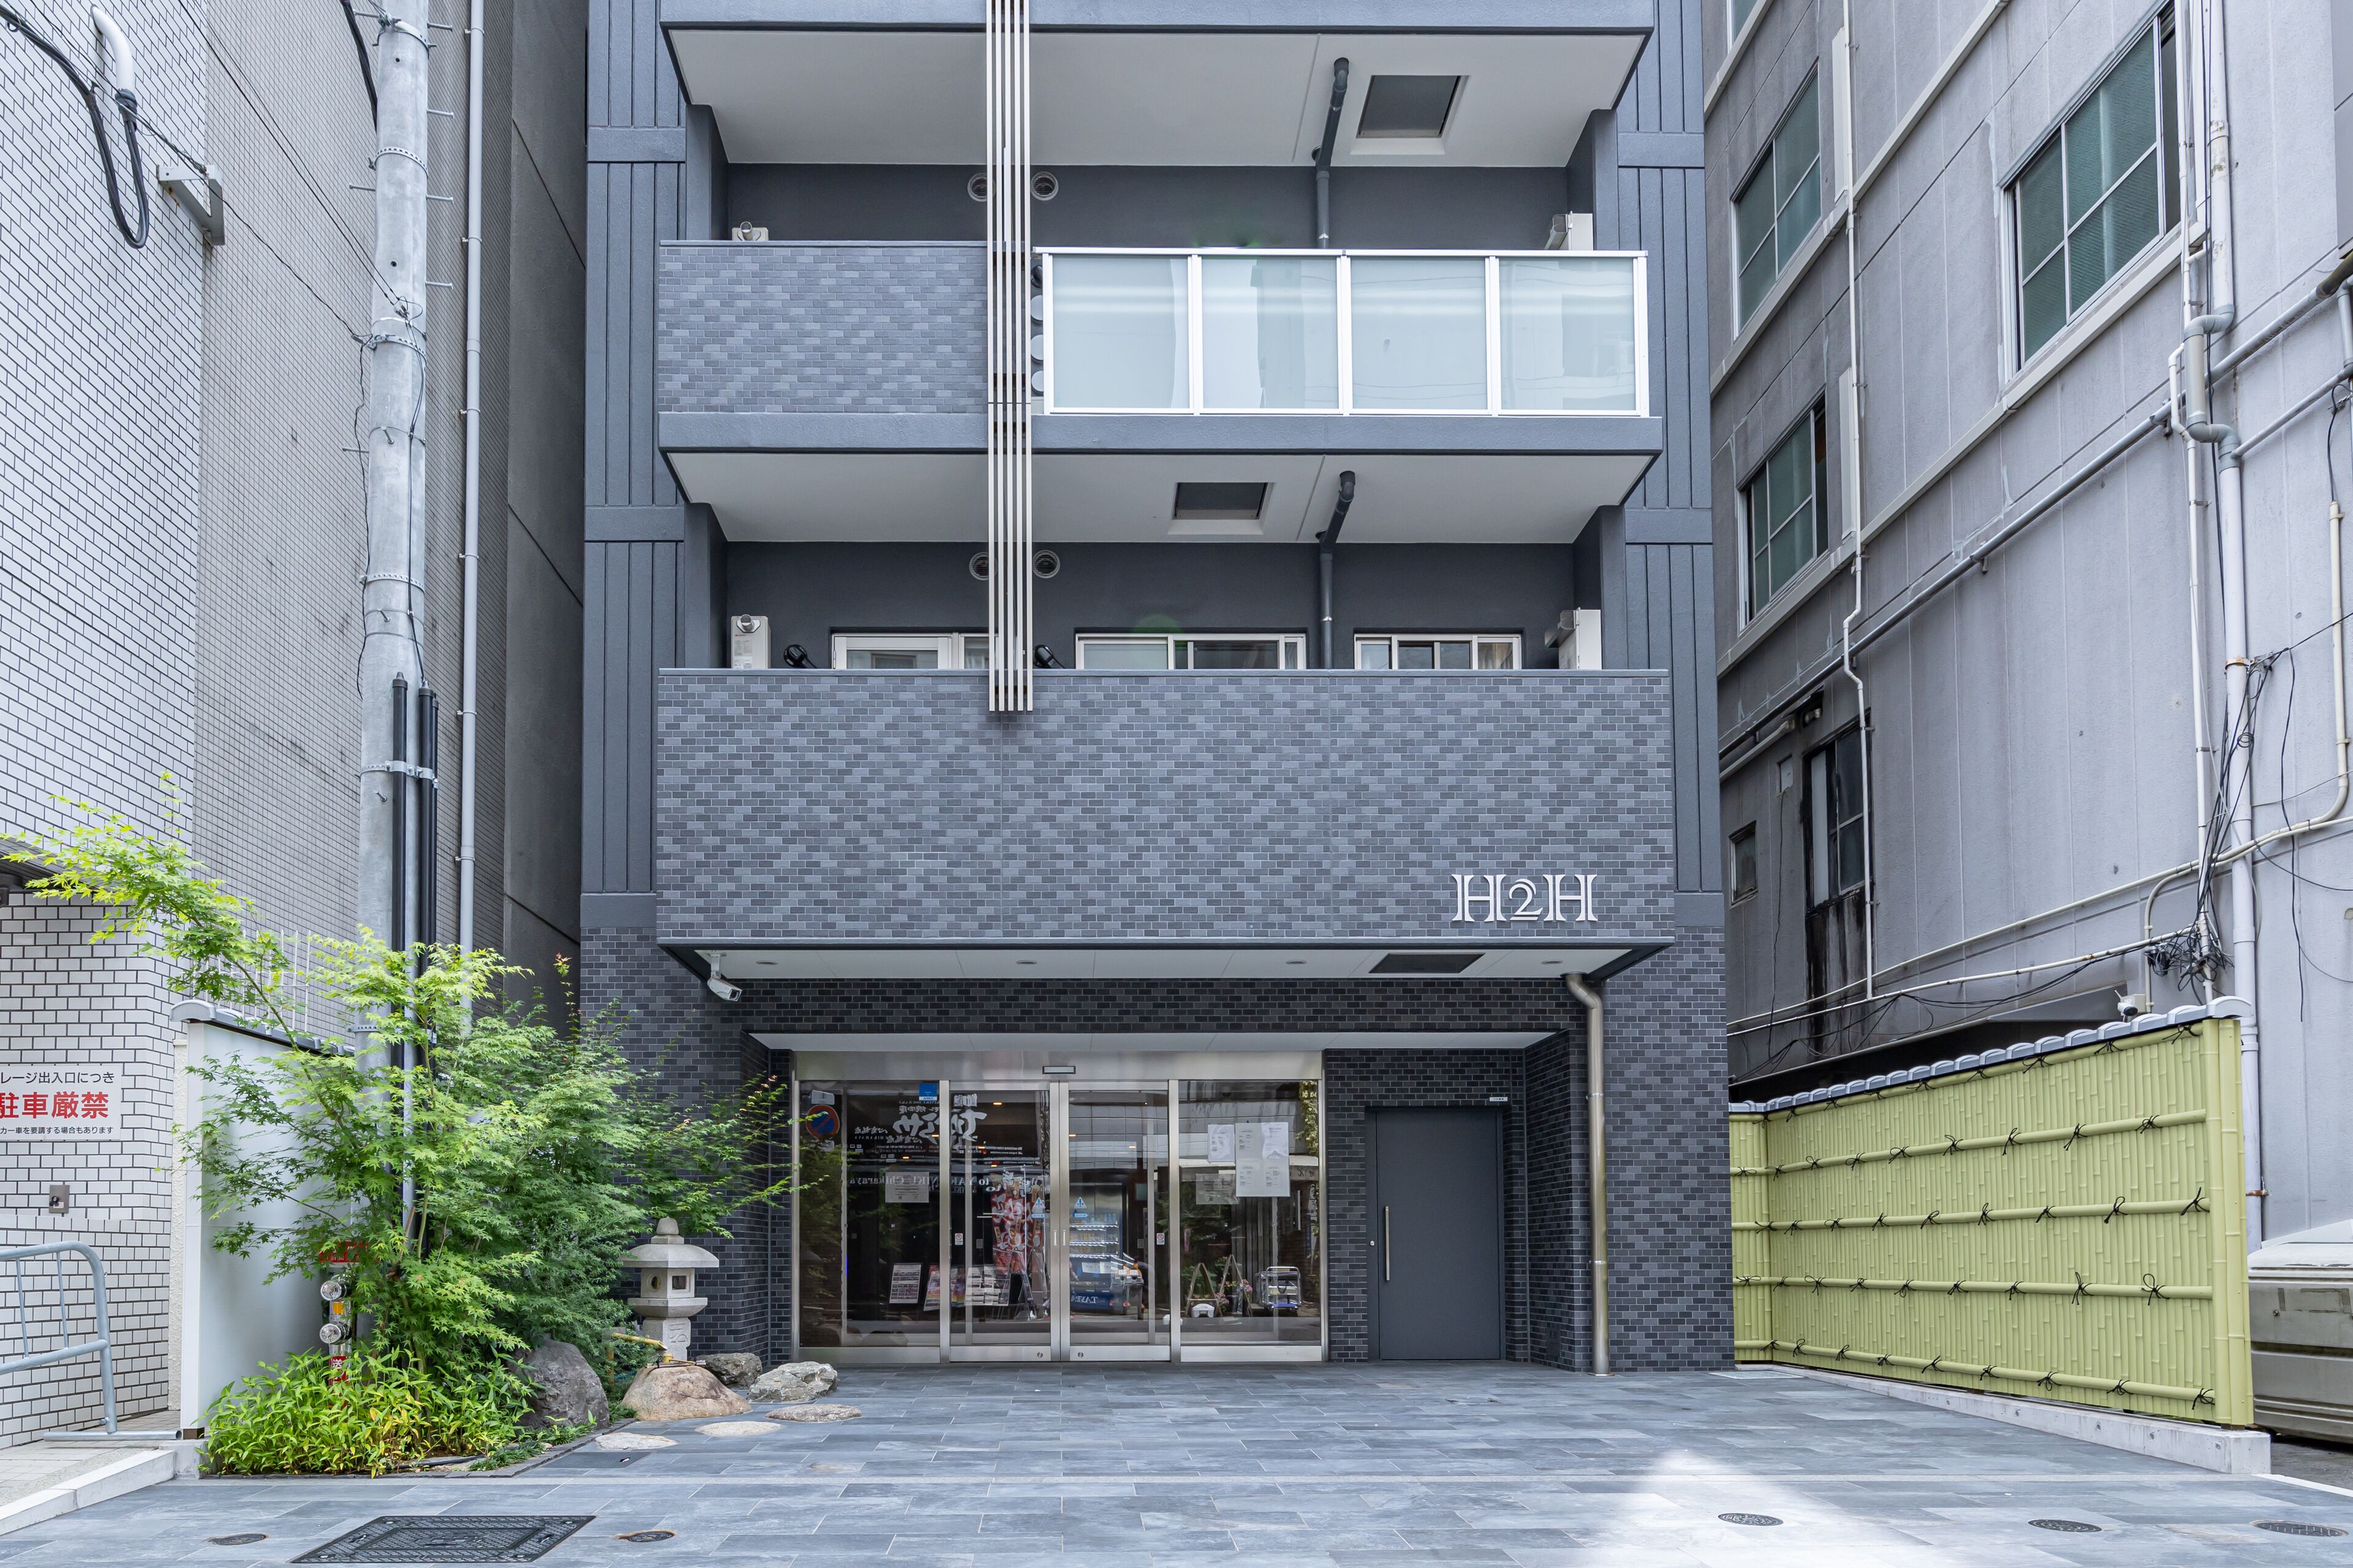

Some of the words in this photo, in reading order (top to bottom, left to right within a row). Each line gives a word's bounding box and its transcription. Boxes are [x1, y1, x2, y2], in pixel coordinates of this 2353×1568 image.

[1452, 874, 1598, 922] H2H
[1, 1072, 115, 1084] レージ出入口につき
[0, 1091, 108, 1119] 駐車厳禁
